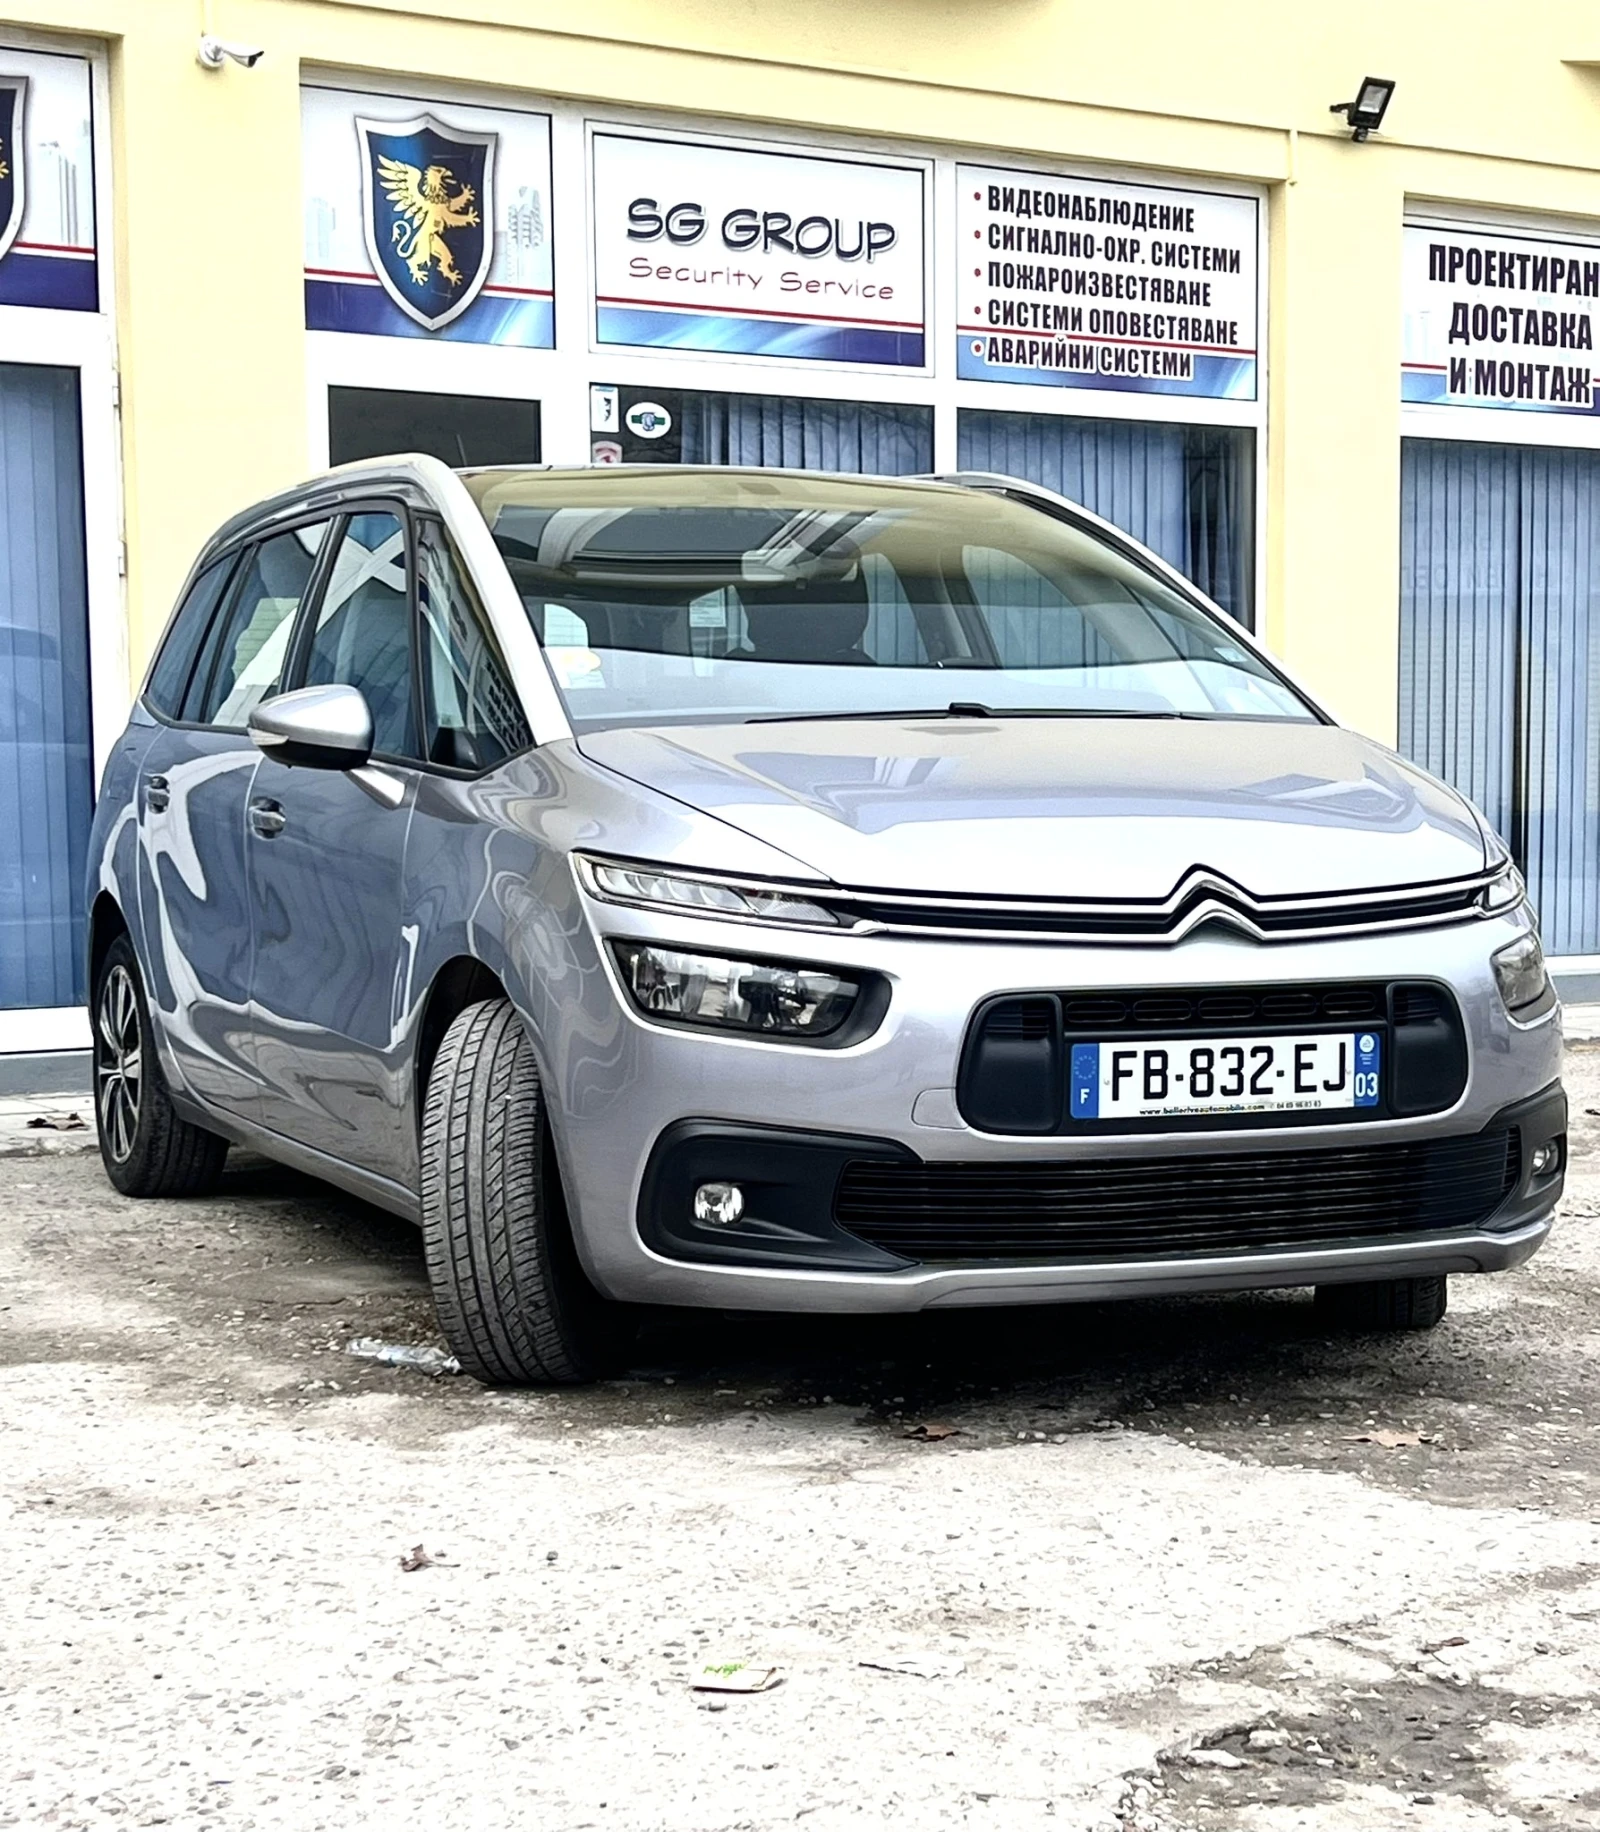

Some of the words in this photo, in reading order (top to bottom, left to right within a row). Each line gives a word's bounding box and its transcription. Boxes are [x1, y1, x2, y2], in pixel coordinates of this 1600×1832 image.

[627, 198, 705, 242] SG
[721, 208, 896, 262] GROUP
[988, 185, 1195, 232] ВИДЕОНАБЛЮДЕНИЕ
[988, 223, 1146, 264] СИГНАЛНО-ОХР.
[1151, 241, 1241, 274] СИСТЕМИ
[1429, 244, 1599, 298] ПРОЕКТИРАН
[629, 257, 763, 290] Security
[780, 272, 894, 299] Service
[988, 261, 1211, 307] ПОЖАРОИЗВЕСТЯВАНЕ
[988, 299, 1082, 331] СИСТЕМИ
[1089, 309, 1238, 345] ОПОВЕСТЯВАНЕ
[1449, 302, 1593, 350] ДОСТАВКА
[988, 337, 1094, 370] АВАРИЙНИ
[1101, 347, 1191, 377] СИСТЕМИ
[1450, 357, 1466, 394] И
[1474, 359, 1590, 404] МОНТАЖ
[1080, 1088, 1090, 1104] F
[1355, 1072, 1378, 1097] 03
